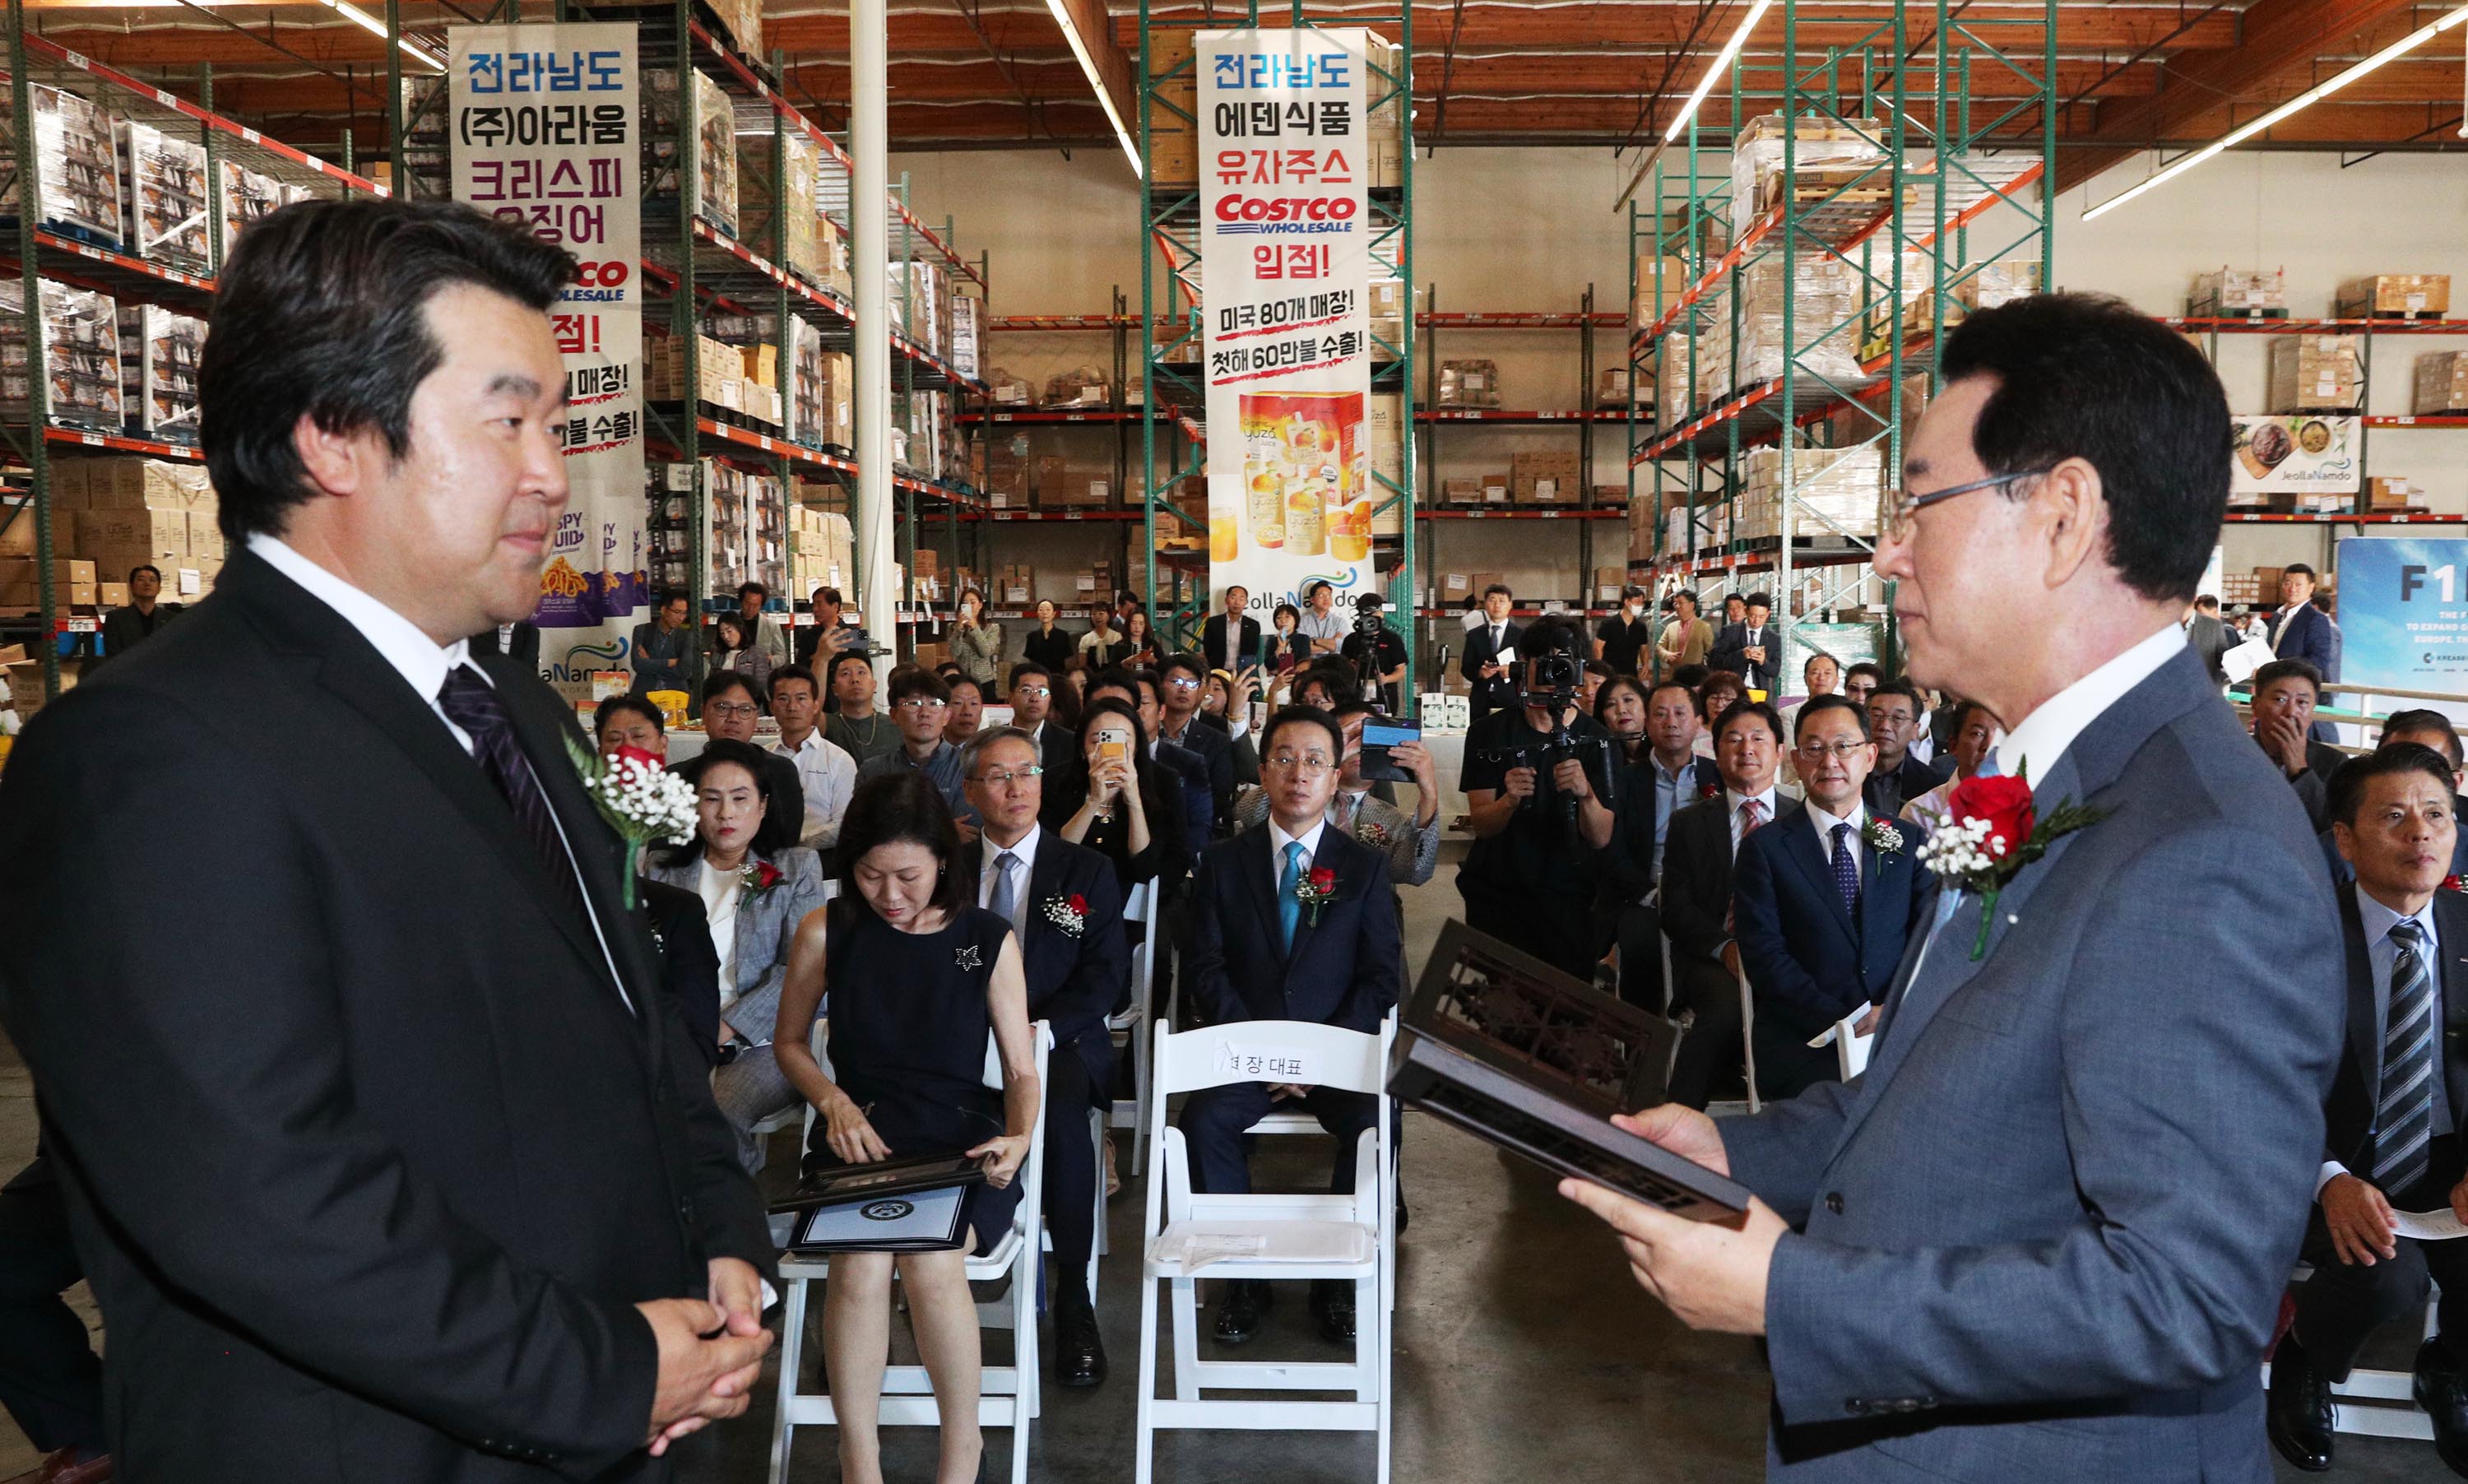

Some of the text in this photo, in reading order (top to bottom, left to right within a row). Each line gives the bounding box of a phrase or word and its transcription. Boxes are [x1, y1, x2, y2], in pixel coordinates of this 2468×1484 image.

[468, 51, 624, 94] 전라남도
[1214, 53, 1351, 90] 전라남도
[460, 104, 628, 147] (주)아라움
[1214, 101, 1352, 137] 에덴식품
[470, 157, 623, 202] 크리스피
[1216, 148, 1352, 185] 유자주스
[1214, 193, 1357, 222] COSTCO
[1259, 222, 1353, 234] WHOLESALE
[1253, 243, 1330, 280] 입점!
[1220, 289, 1354, 332] 미국 80개 매장!
[551, 314, 601, 354] 점!
[1212, 330, 1363, 377] 첫해 60만불 수출!
[578, 364, 629, 396] 매장!
[592, 410, 638, 442] 수출!
[2401, 564, 2468, 602] F1
[1269, 1057, 1302, 1076] 대표
